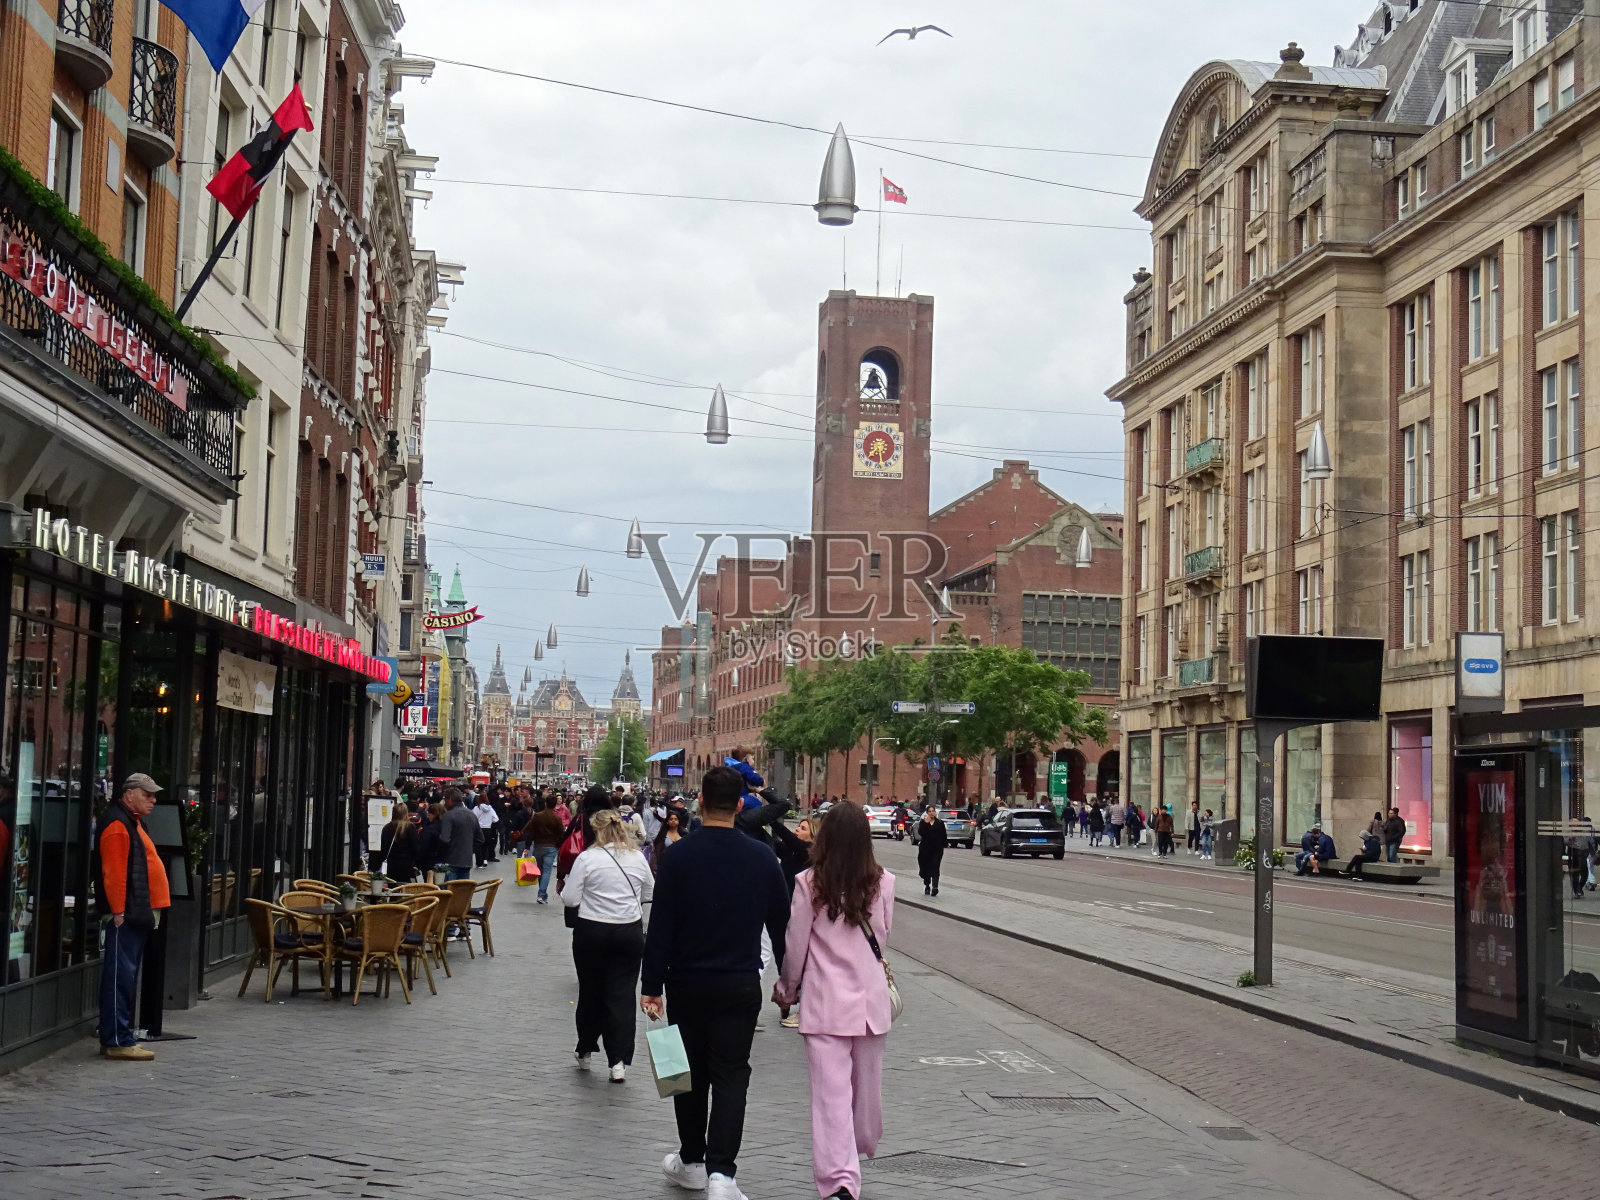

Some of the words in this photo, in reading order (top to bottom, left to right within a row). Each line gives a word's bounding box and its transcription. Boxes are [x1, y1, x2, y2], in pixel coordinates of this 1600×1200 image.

[107, 315, 177, 394] LEEUW
[33, 508, 117, 576] HOTEL
[126, 550, 236, 623] AMSTERDAM
[423, 611, 475, 628] CASINO
[1478, 783, 1506, 814] YUM
[1471, 909, 1514, 929] UNLIMITED
